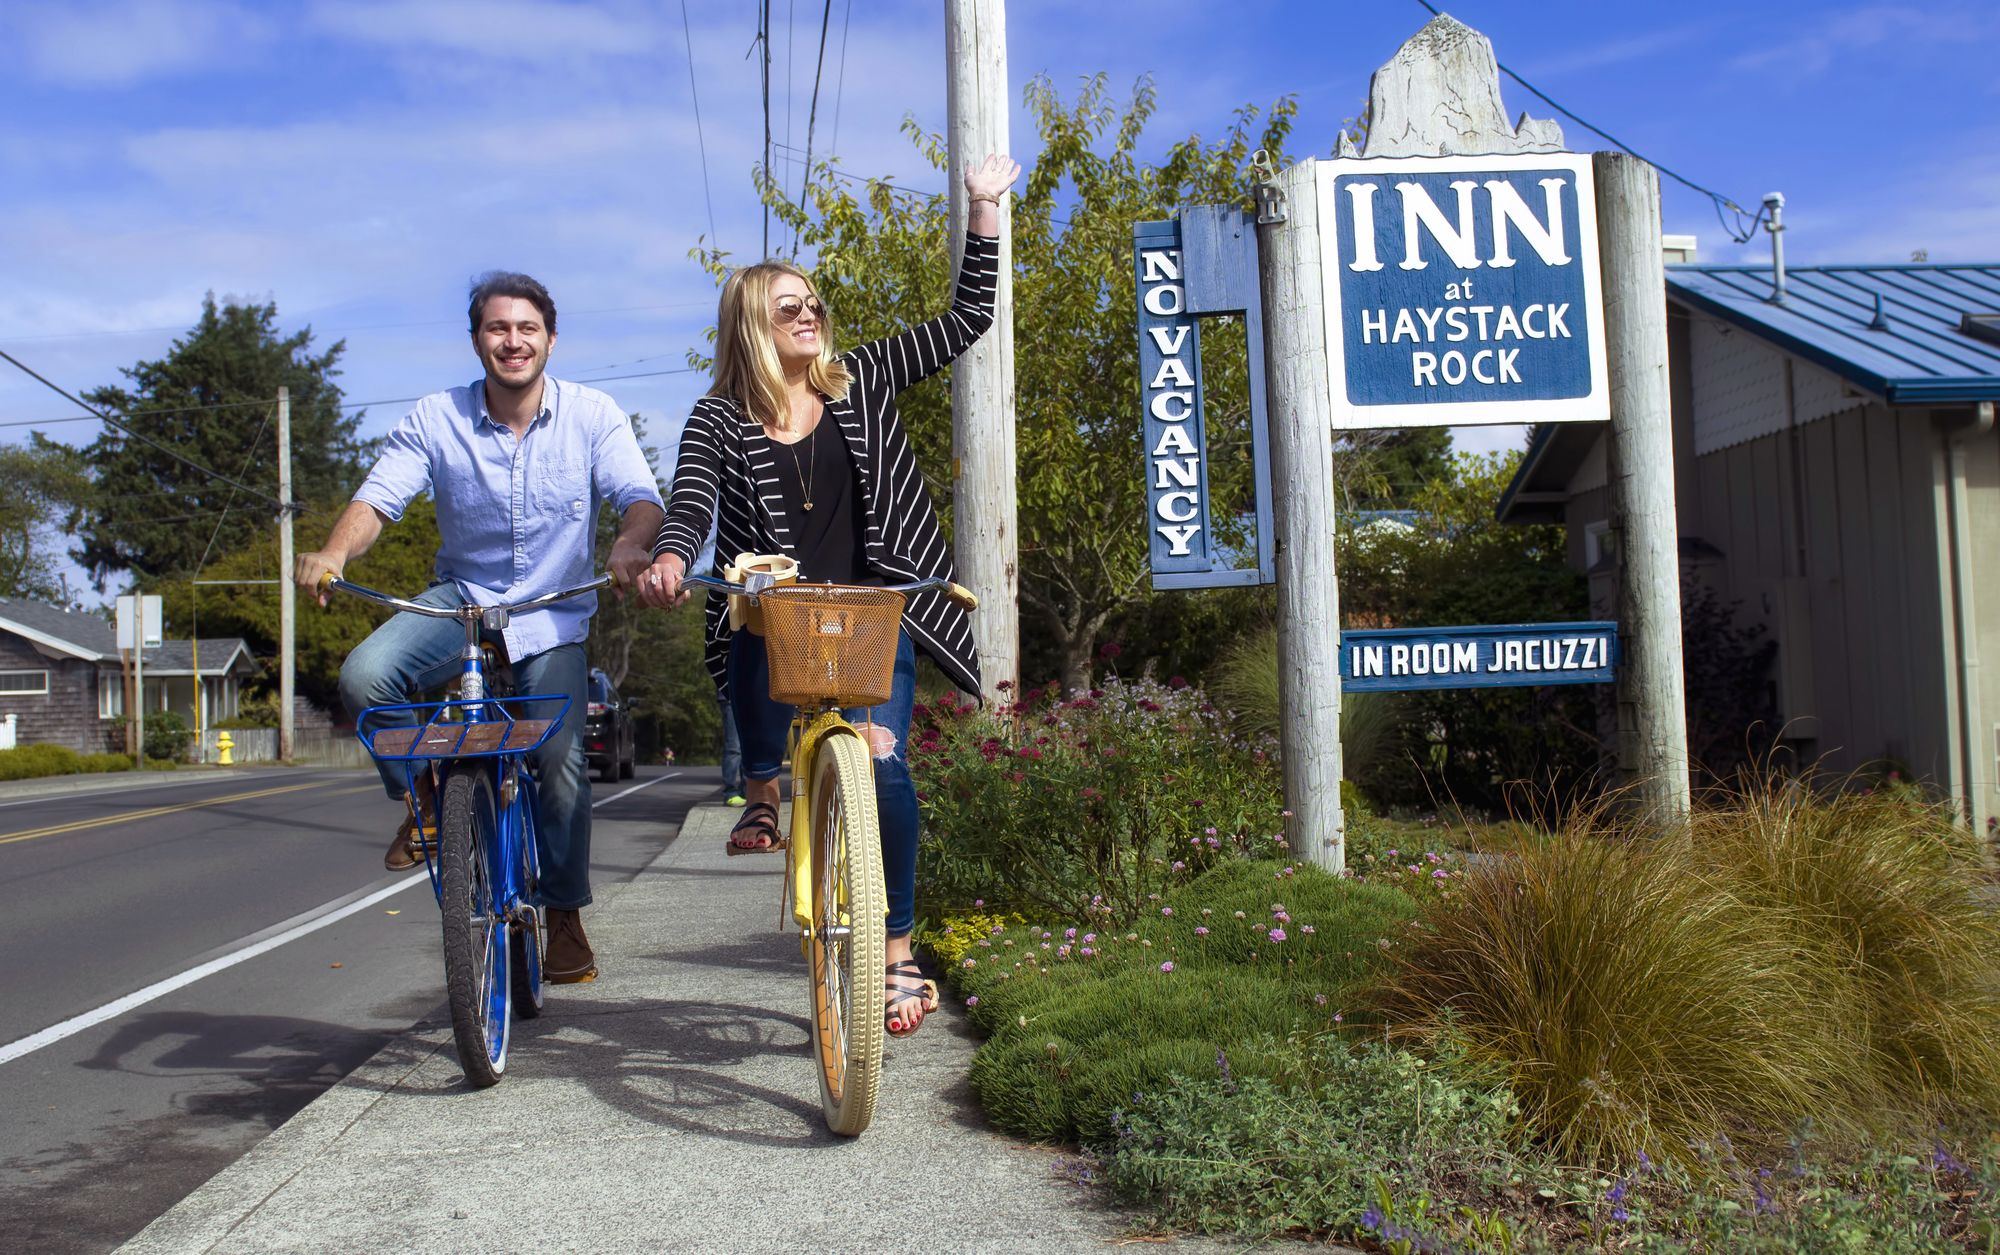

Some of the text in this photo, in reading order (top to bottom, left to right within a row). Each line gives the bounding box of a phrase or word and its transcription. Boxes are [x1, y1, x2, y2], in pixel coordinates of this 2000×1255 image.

[1344, 177, 1572, 272] INN
[1444, 276, 1474, 301] at
[1361, 303, 1572, 344] HAYSTACK
[1411, 348, 1522, 387] ROCK
[1141, 251, 1201, 556] NO VACANCY
[1352, 637, 1607, 677] IN ROOM JACUZZI
